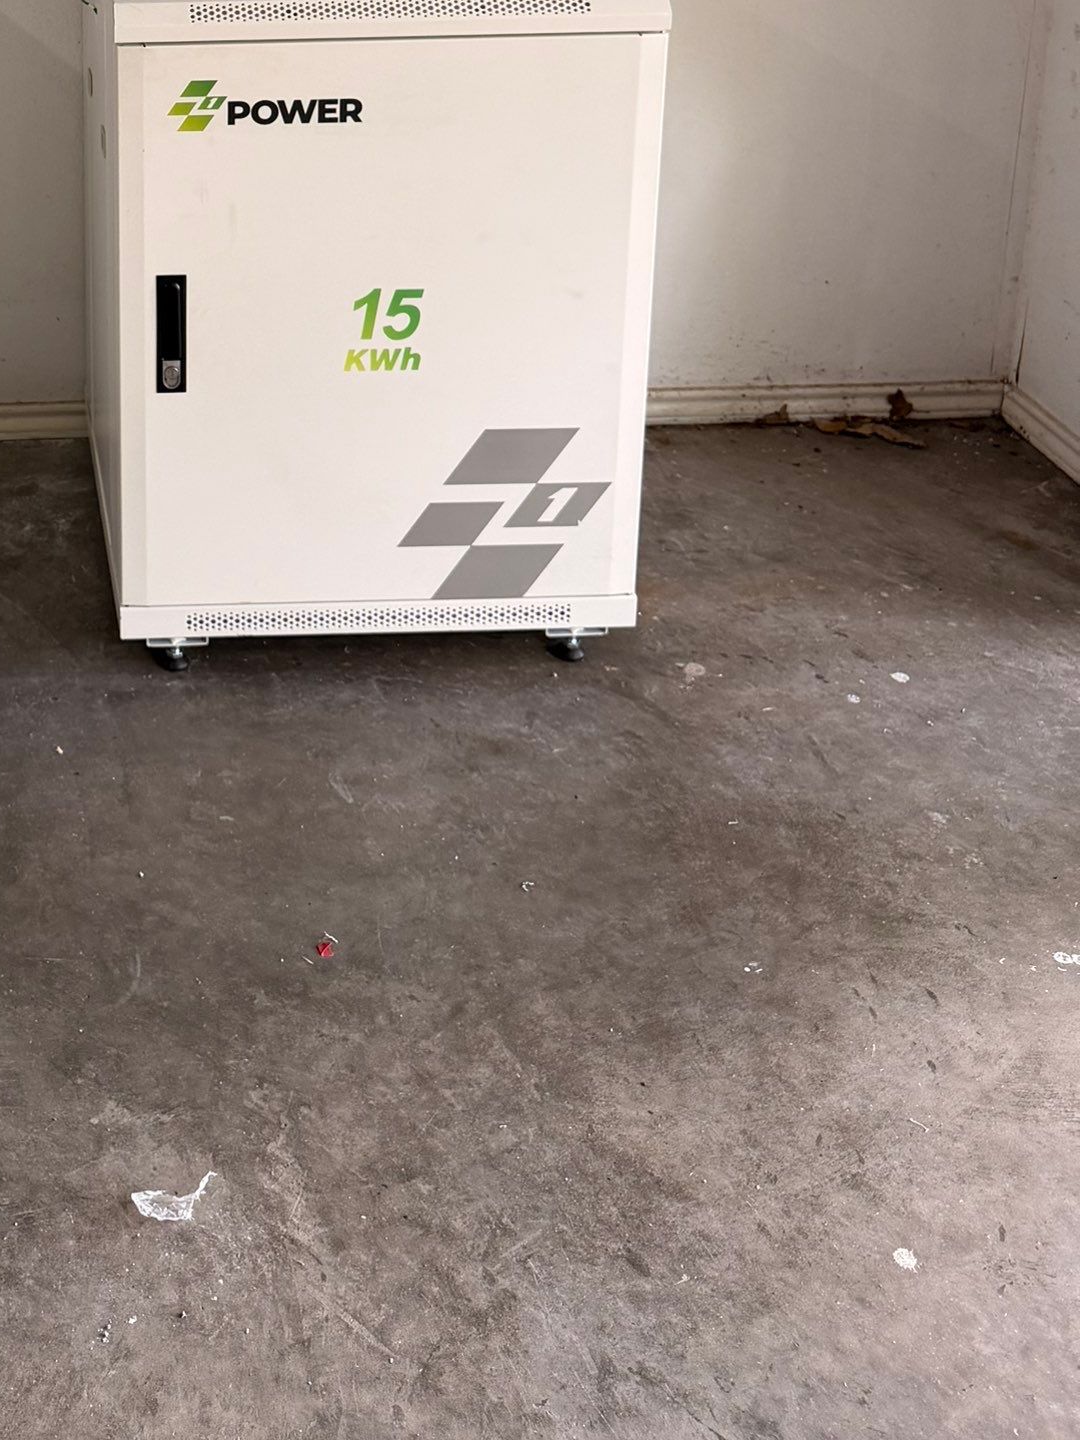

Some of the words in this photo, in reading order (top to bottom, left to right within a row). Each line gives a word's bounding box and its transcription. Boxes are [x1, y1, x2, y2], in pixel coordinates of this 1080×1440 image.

[206, 97, 218, 109] 1
[227, 98, 364, 125] POWER
[353, 288, 424, 340] 15
[343, 347, 421, 372] KWh
[537, 486, 579, 522] 1
